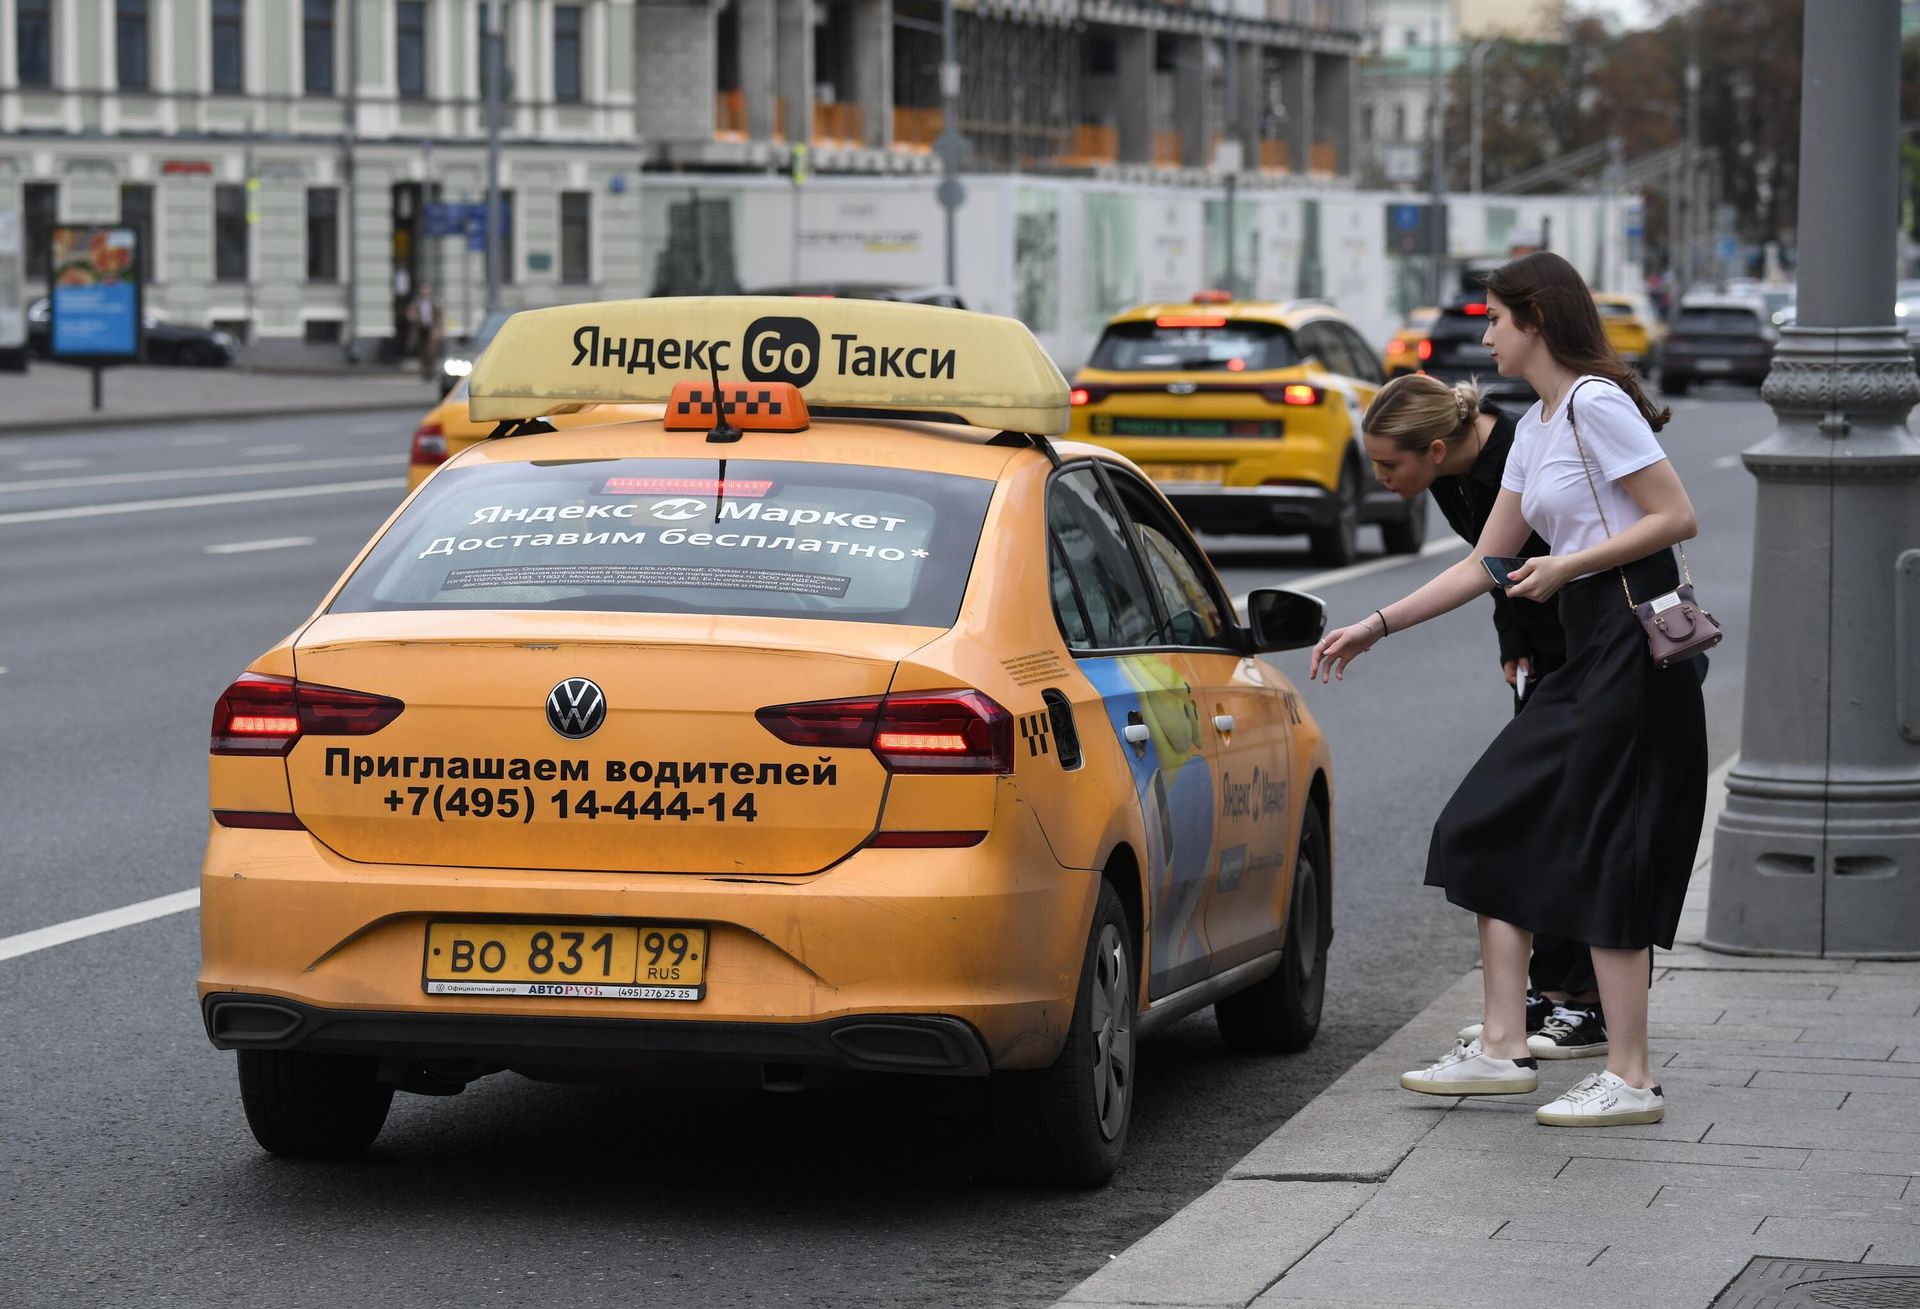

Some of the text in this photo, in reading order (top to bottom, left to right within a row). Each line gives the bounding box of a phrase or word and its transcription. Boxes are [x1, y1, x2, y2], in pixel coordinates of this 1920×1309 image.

[571, 326, 956, 379] Яндекс Go Такси
[469, 501, 905, 532] Яндекс Маркет
[418, 531, 646, 560] Доставим
[325, 748, 837, 788] Приглашаем водителей
[384, 785, 757, 824] +7(495) 14-444-14
[528, 931, 613, 976] 831
[644, 932, 688, 966] 99
[648, 967, 680, 980] RUS
[447, 984, 495, 992] Официальный
[528, 985, 603, 996] АВТОРУСЬ
[618, 988, 690, 999] (495) 276 25 25
